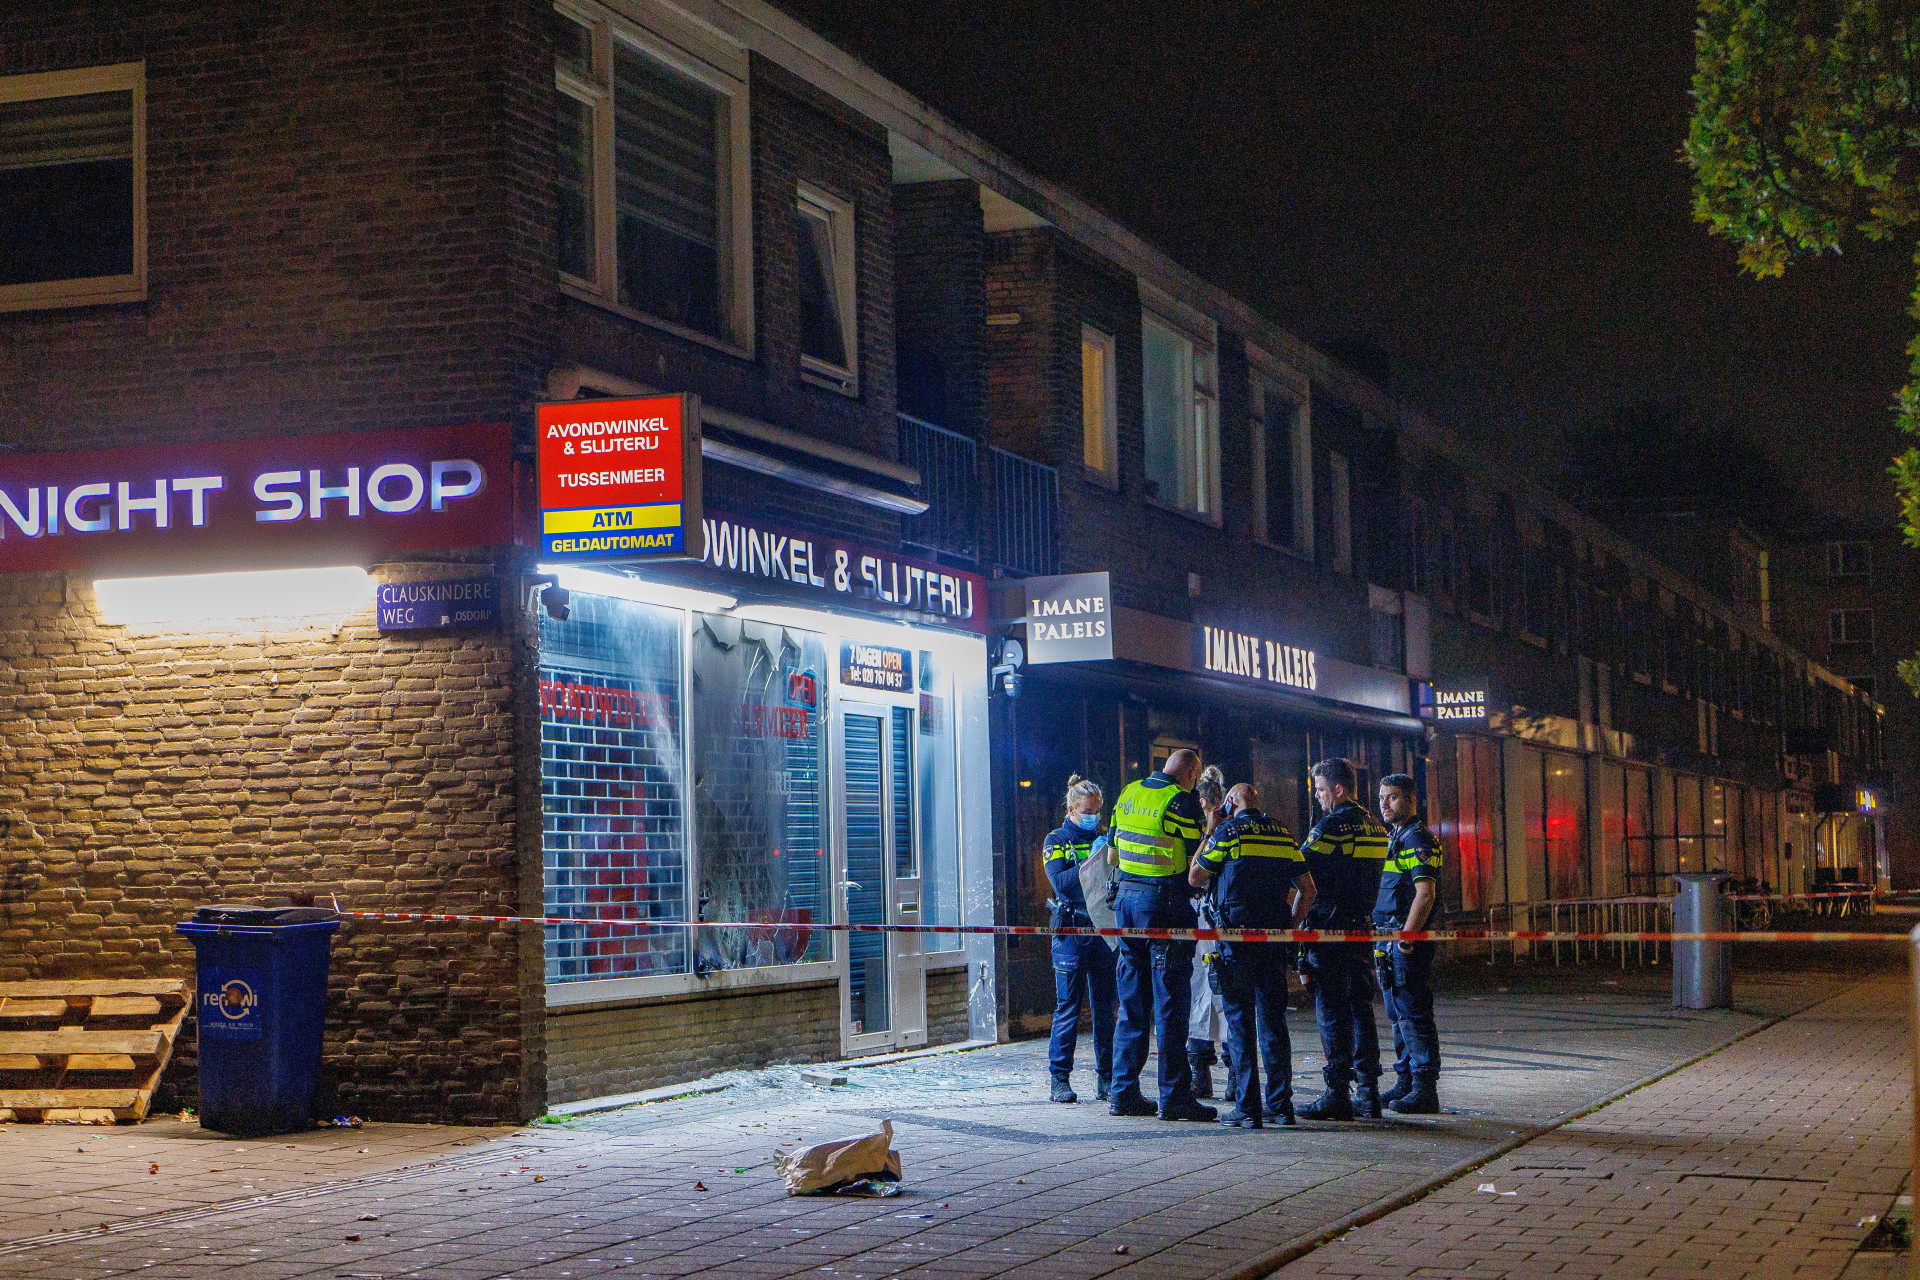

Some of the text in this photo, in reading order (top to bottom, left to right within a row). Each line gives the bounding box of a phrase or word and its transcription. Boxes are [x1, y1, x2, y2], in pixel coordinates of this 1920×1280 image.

[546, 417, 669, 439] AVONDWINKEL
[563, 435, 659, 455] & SLIJTERIJ
[557, 468, 665, 488] TUSSENMEER
[0, 459, 486, 538] NIGHT SHOP
[592, 511, 633, 528] ATM
[551, 533, 674, 553] GELDAUTOMAAT
[382, 583, 492, 603] CLAUSKINDERE
[834, 549, 852, 592] &
[861, 555, 974, 619] SLIJTERIJ
[382, 607, 415, 625] WEG
[1032, 596, 1105, 617] IMANE
[1033, 620, 1106, 641] PALEIS
[849, 645, 902, 670] 7 DAGEN OPEN
[1204, 625, 1316, 691] IMANE PALEIS
[850, 666, 903, 687] Tel: 020 767 04 37
[787, 671, 816, 705] OPEN
[1435, 690, 1485, 705] IMANE
[1436, 706, 1486, 720] PALEIS
[1117, 797, 1159, 818] POLITIE
